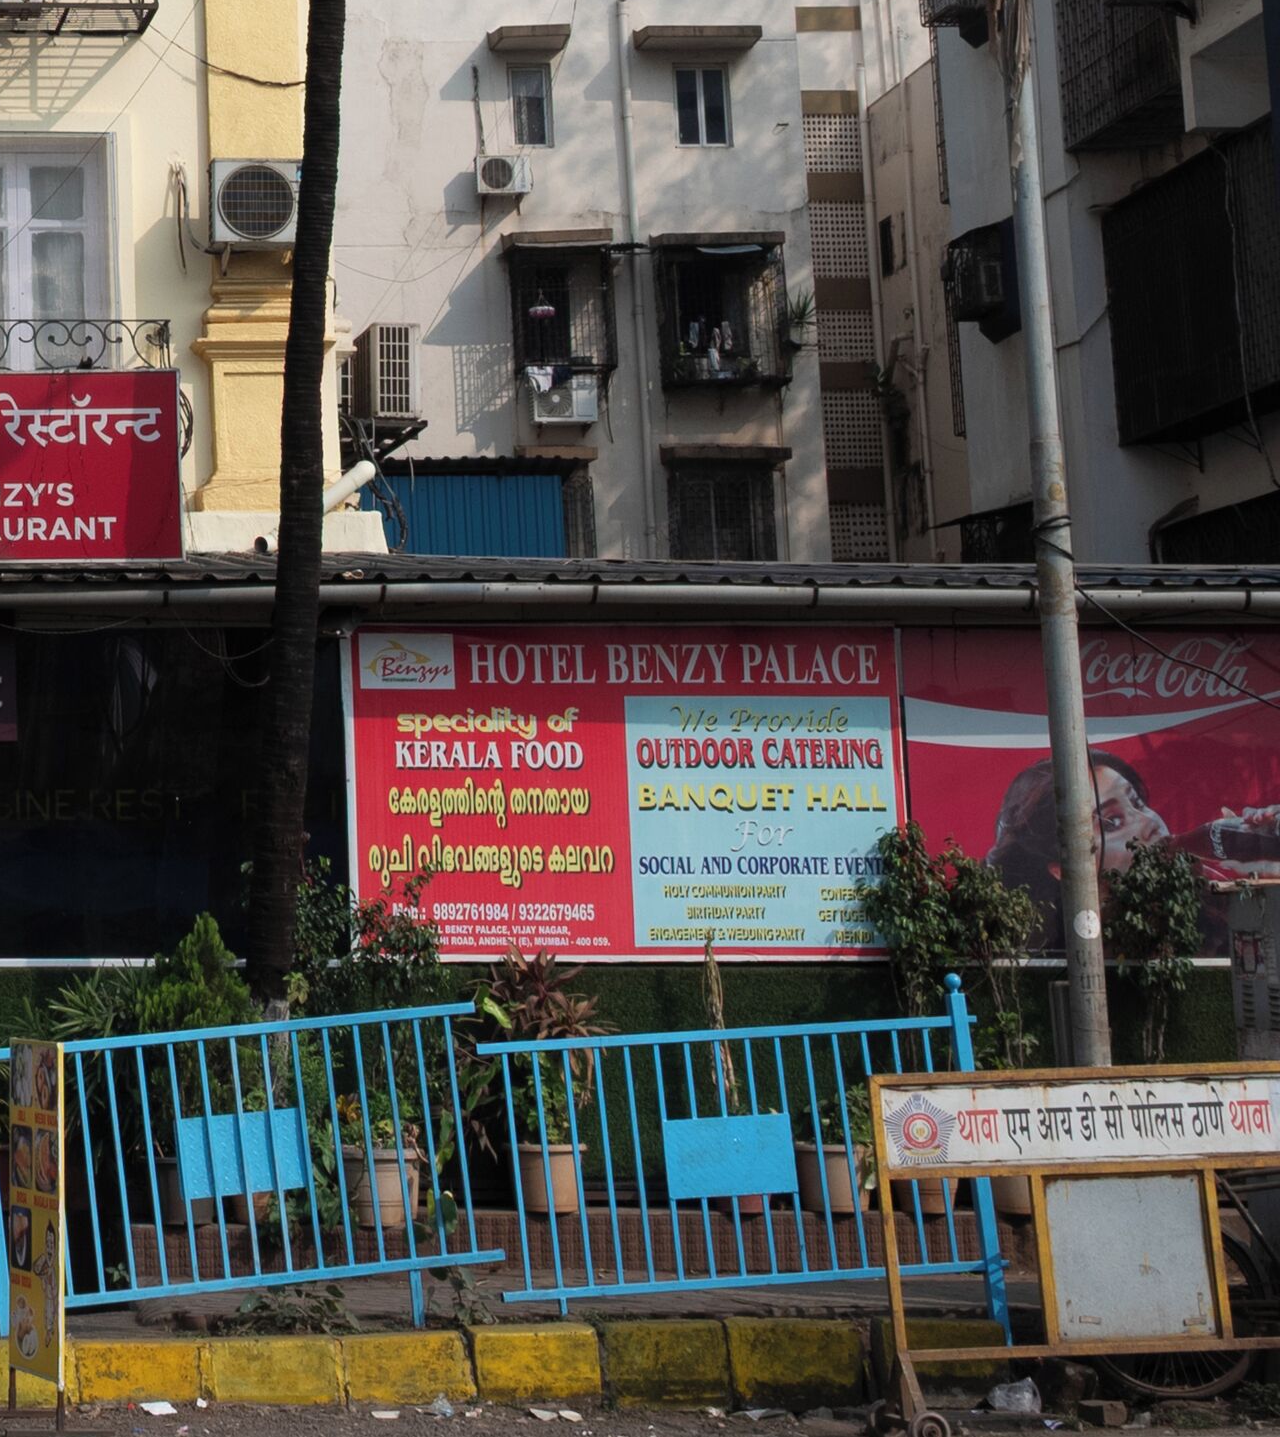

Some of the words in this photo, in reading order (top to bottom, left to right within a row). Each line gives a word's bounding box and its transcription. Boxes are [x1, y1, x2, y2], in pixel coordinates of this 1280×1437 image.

[469, 644, 596, 684] HOTEL
[606, 644, 729, 684] BENZY
[740, 644, 880, 685] PALACE
[397, 707, 537, 739] speciality
[547, 707, 580, 733] of
[671, 705, 718, 732] We
[730, 706, 848, 733] Provide
[395, 741, 502, 770] KERALA
[511, 741, 584, 770] FOOD
[637, 738, 755, 769] OUTDOOR
[762, 738, 883, 770] CATERING
[638, 784, 794, 814] BANQUET
[807, 785, 887, 812] HALL
[731, 820, 793, 852] For
[639, 855, 695, 876] SOCIAL
[701, 856, 732, 876] AND
[737, 856, 829, 876] CORPORATE
[664, 885, 690, 898] HOLY
[691, 885, 755, 898] COMMUNION
[756, 885, 786, 899] PARTY
[433, 903, 509, 922] 9892761984
[519, 904, 595, 922] 9322679465
[687, 906, 734, 920] BIRTHDAY
[736, 906, 765, 920] PARTY
